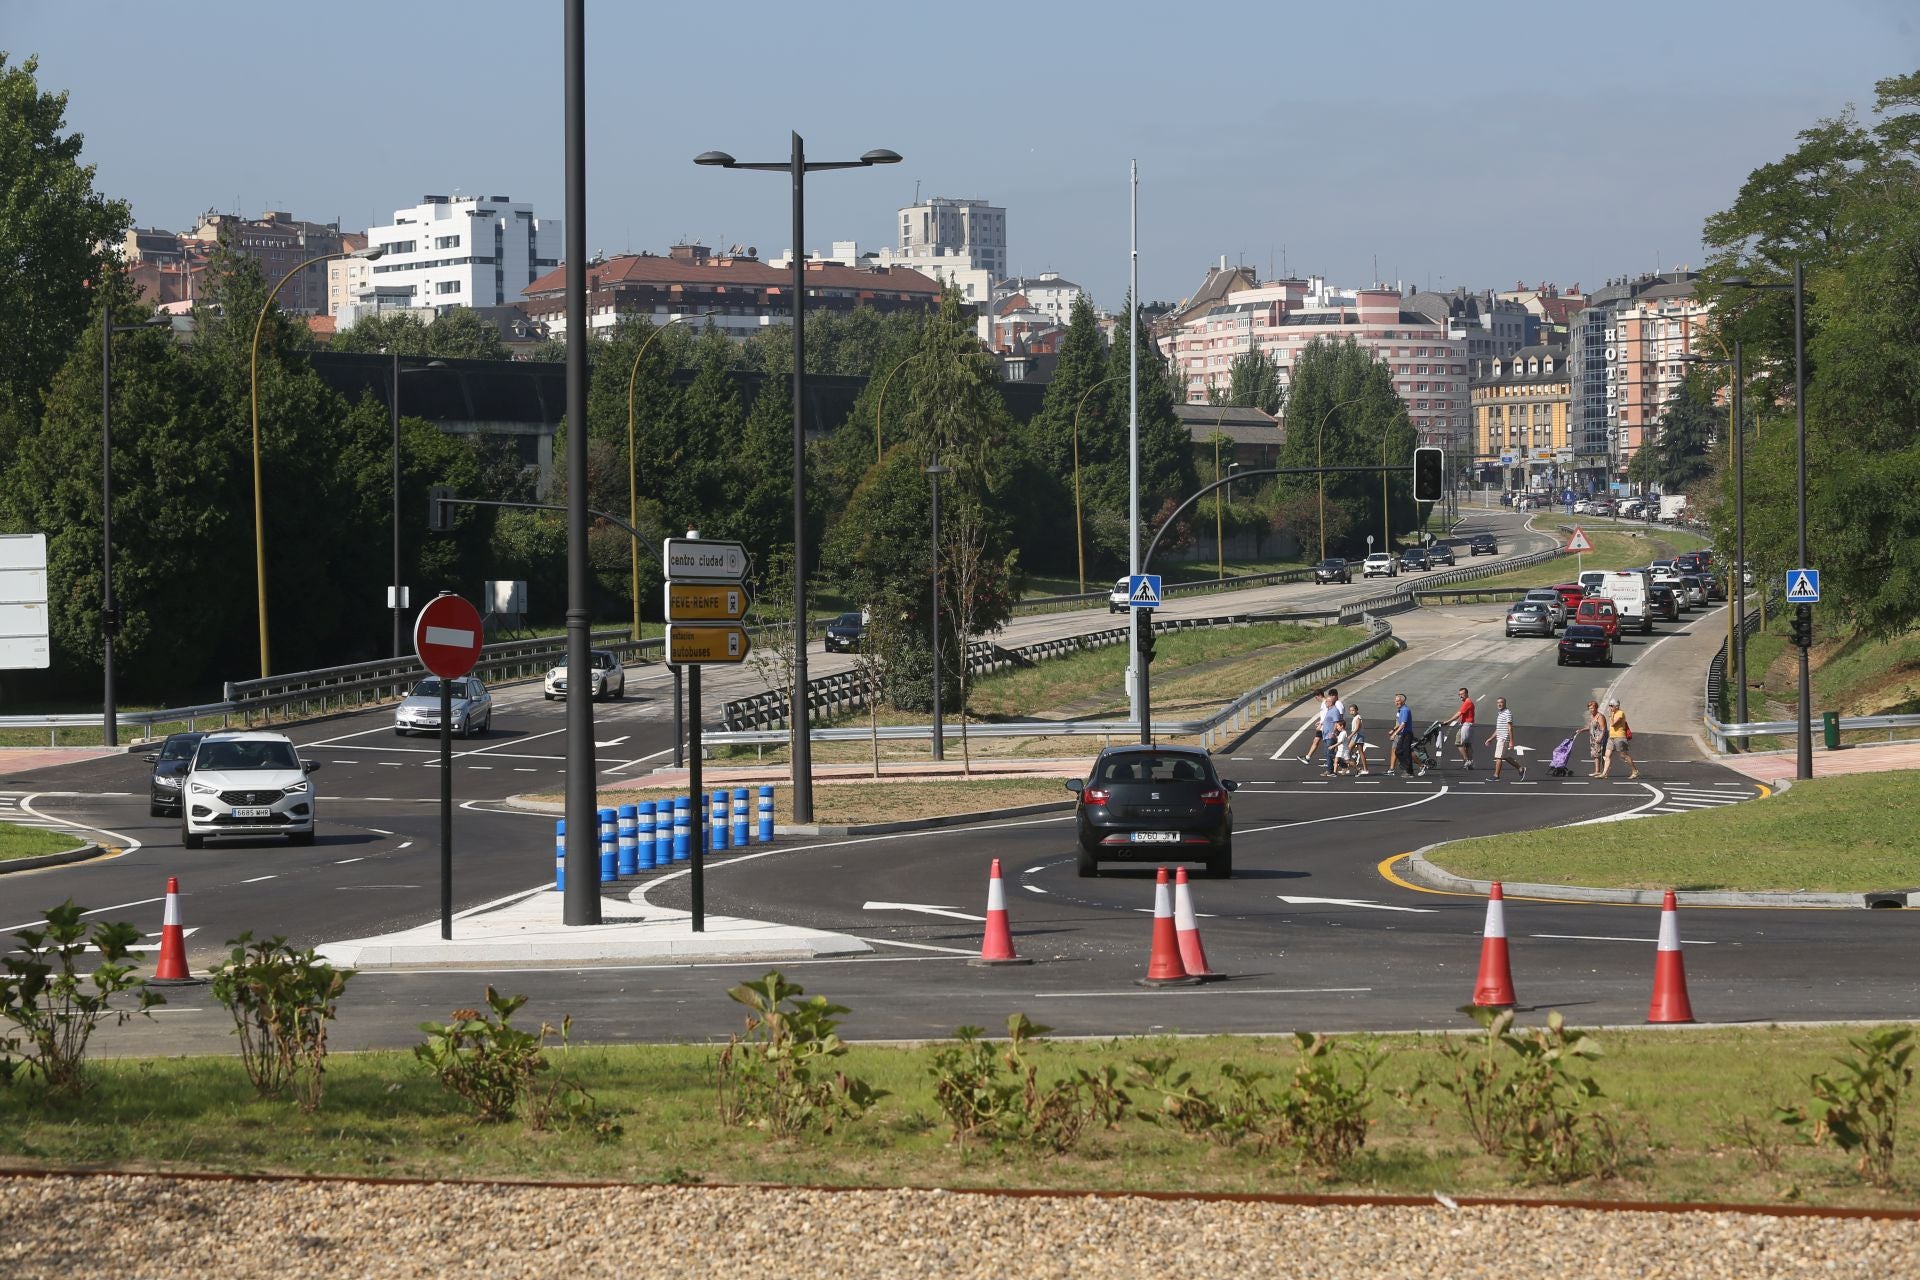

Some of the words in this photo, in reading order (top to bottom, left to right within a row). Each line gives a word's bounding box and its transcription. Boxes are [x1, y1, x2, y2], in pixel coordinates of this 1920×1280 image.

[1605, 329, 1617, 417] HOTEL
[671, 554, 695, 566] centro
[699, 554, 724, 567] ciudad
[237, 809, 254, 817] 6685
[1137, 831, 1158, 840] 6760
